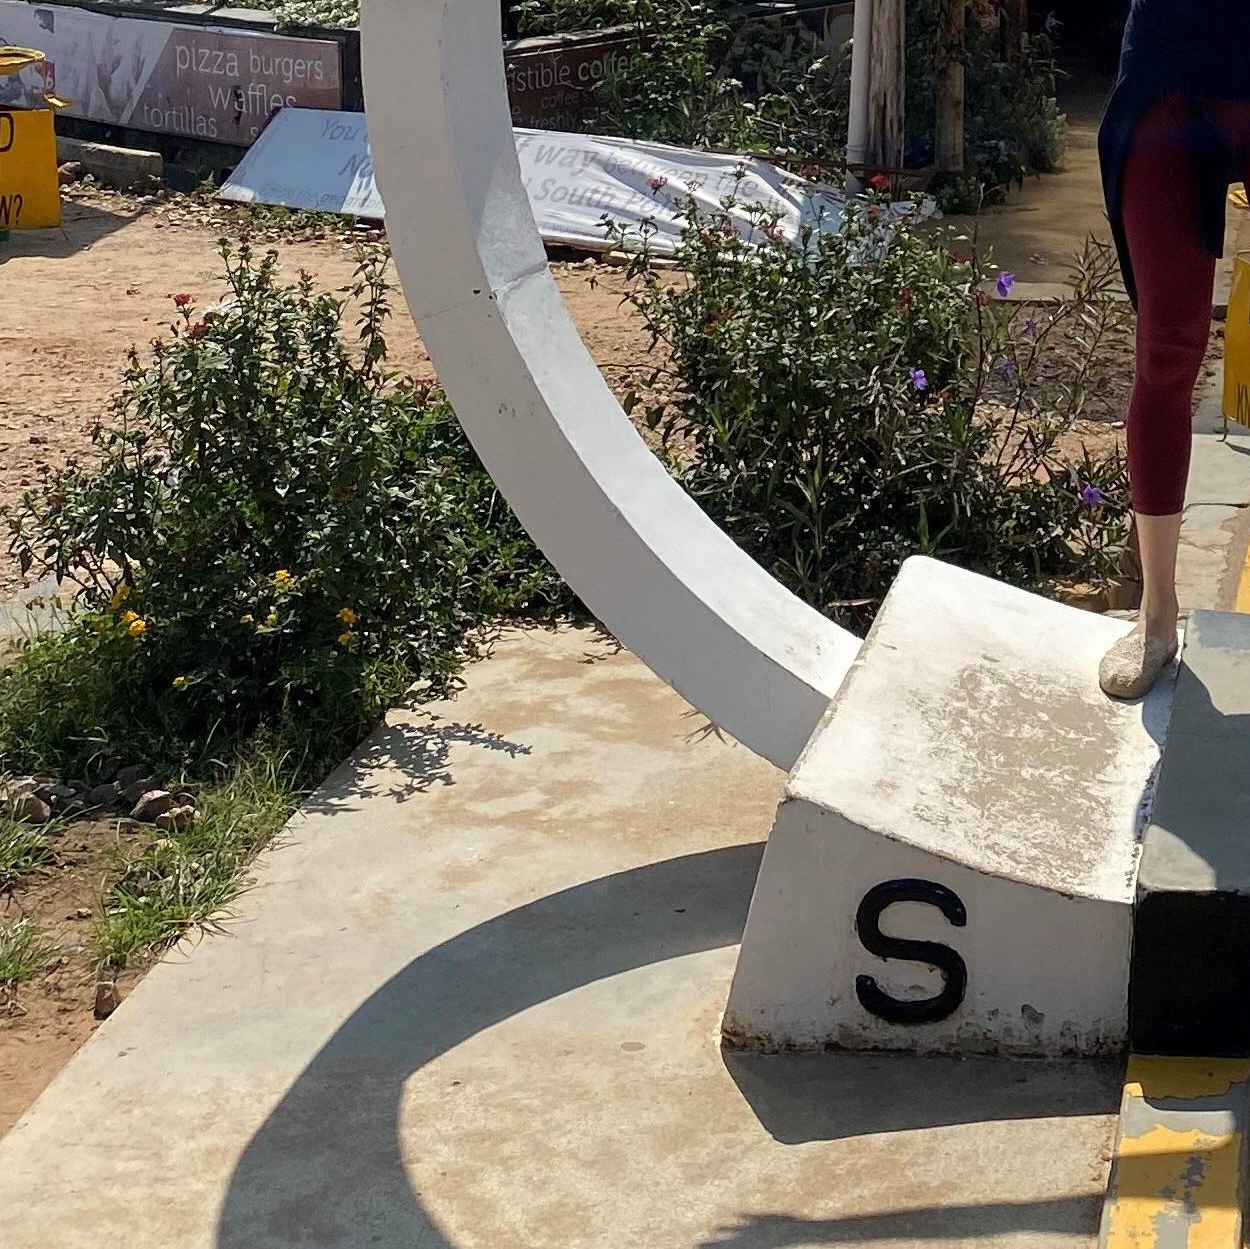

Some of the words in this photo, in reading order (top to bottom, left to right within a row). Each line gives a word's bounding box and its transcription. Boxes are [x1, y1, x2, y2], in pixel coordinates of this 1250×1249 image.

[175, 39, 240, 77] pizza
[250, 50, 323, 83] burgers
[144, 97, 218, 138] tortillas
[320, 119, 361, 141] You
[856, 877, 968, 1025] S
